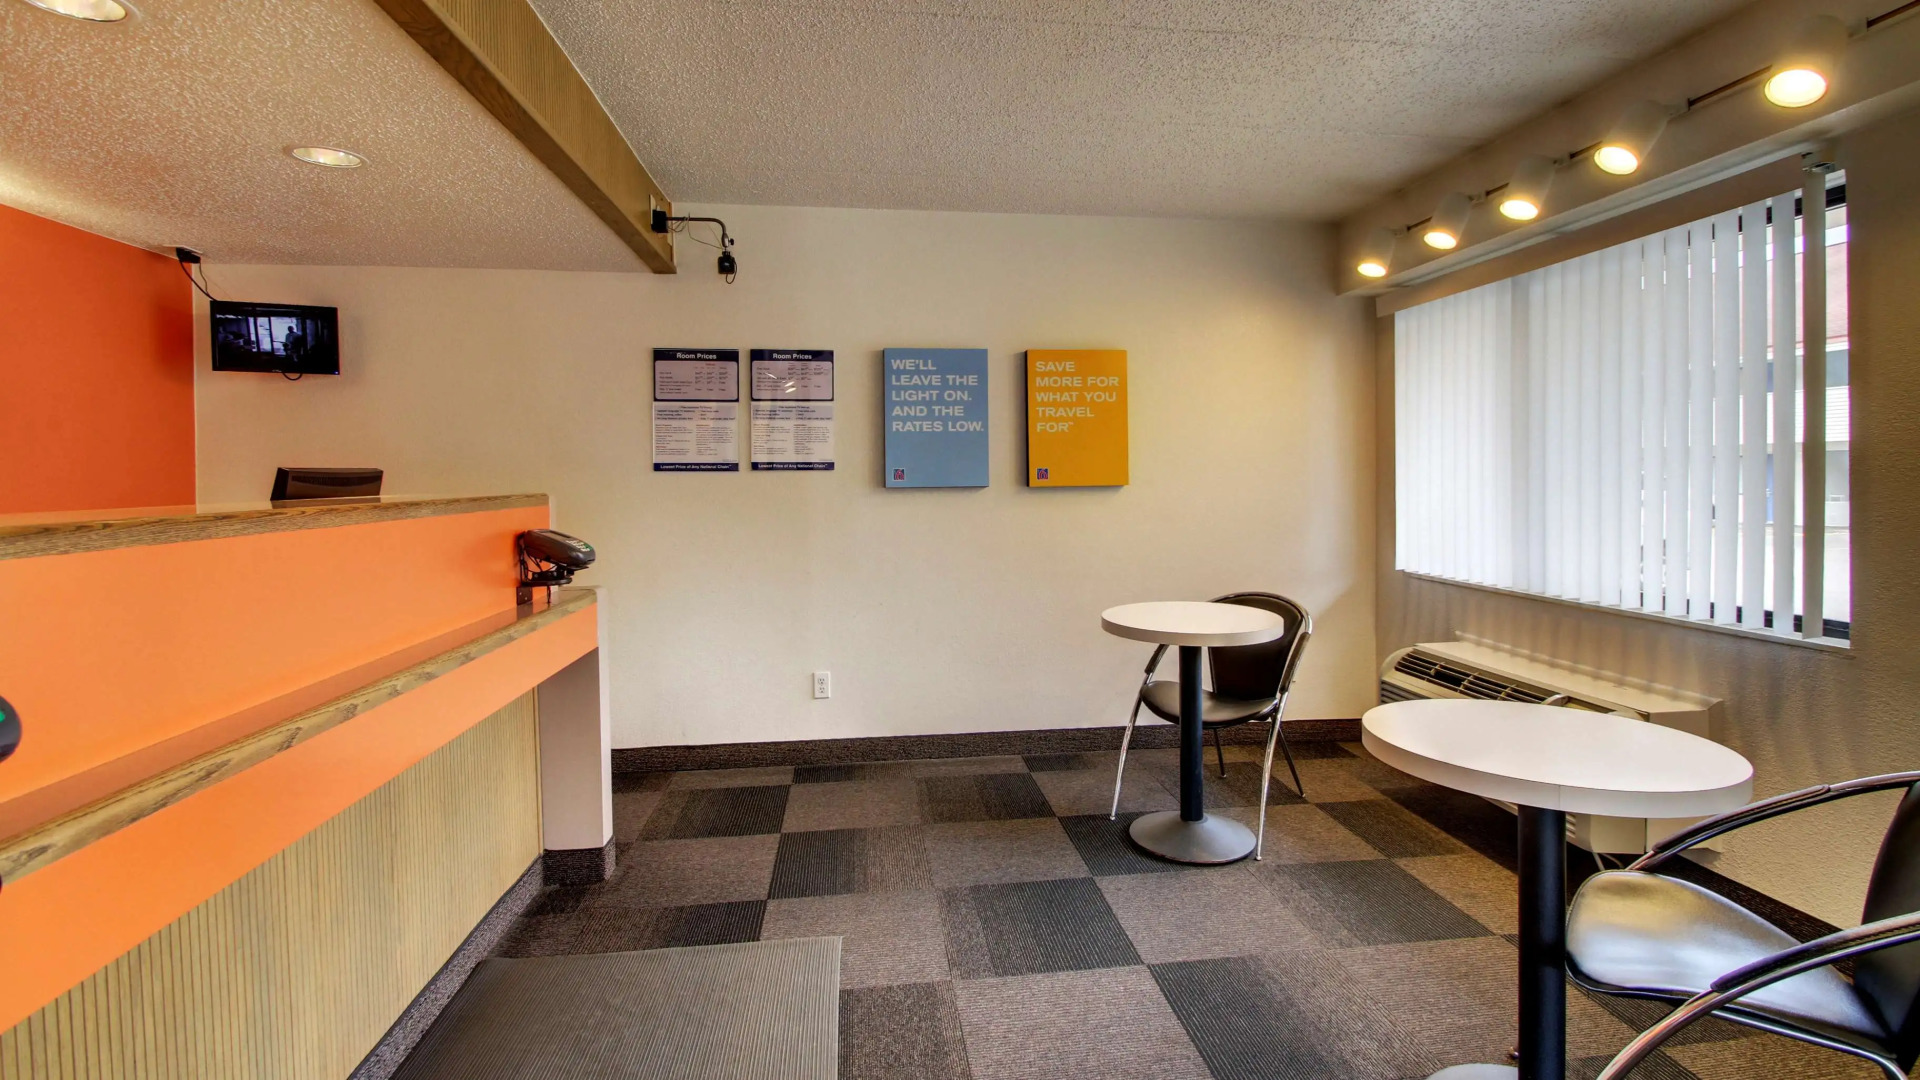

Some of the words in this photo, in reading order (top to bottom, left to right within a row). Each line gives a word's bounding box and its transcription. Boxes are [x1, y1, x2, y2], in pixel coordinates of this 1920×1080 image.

[892, 359, 936, 370] WE'LL
[1036, 362, 1075, 372] SAVE
[892, 375, 941, 385] LEAVE
[946, 375, 978, 385] THE
[1036, 377, 1082, 387] MORE
[1088, 377, 1119, 386] FOR
[892, 390, 940, 401] LIGHT
[944, 391, 972, 401] ON.
[1036, 392, 1078, 402] WHAT
[1084, 392, 1116, 402] YOU
[892, 406, 927, 416] AND
[932, 406, 964, 416] THE
[1036, 407, 1094, 417] TRAVEL
[892, 421, 943, 432] RATES
[948, 421, 984, 432] LOW.
